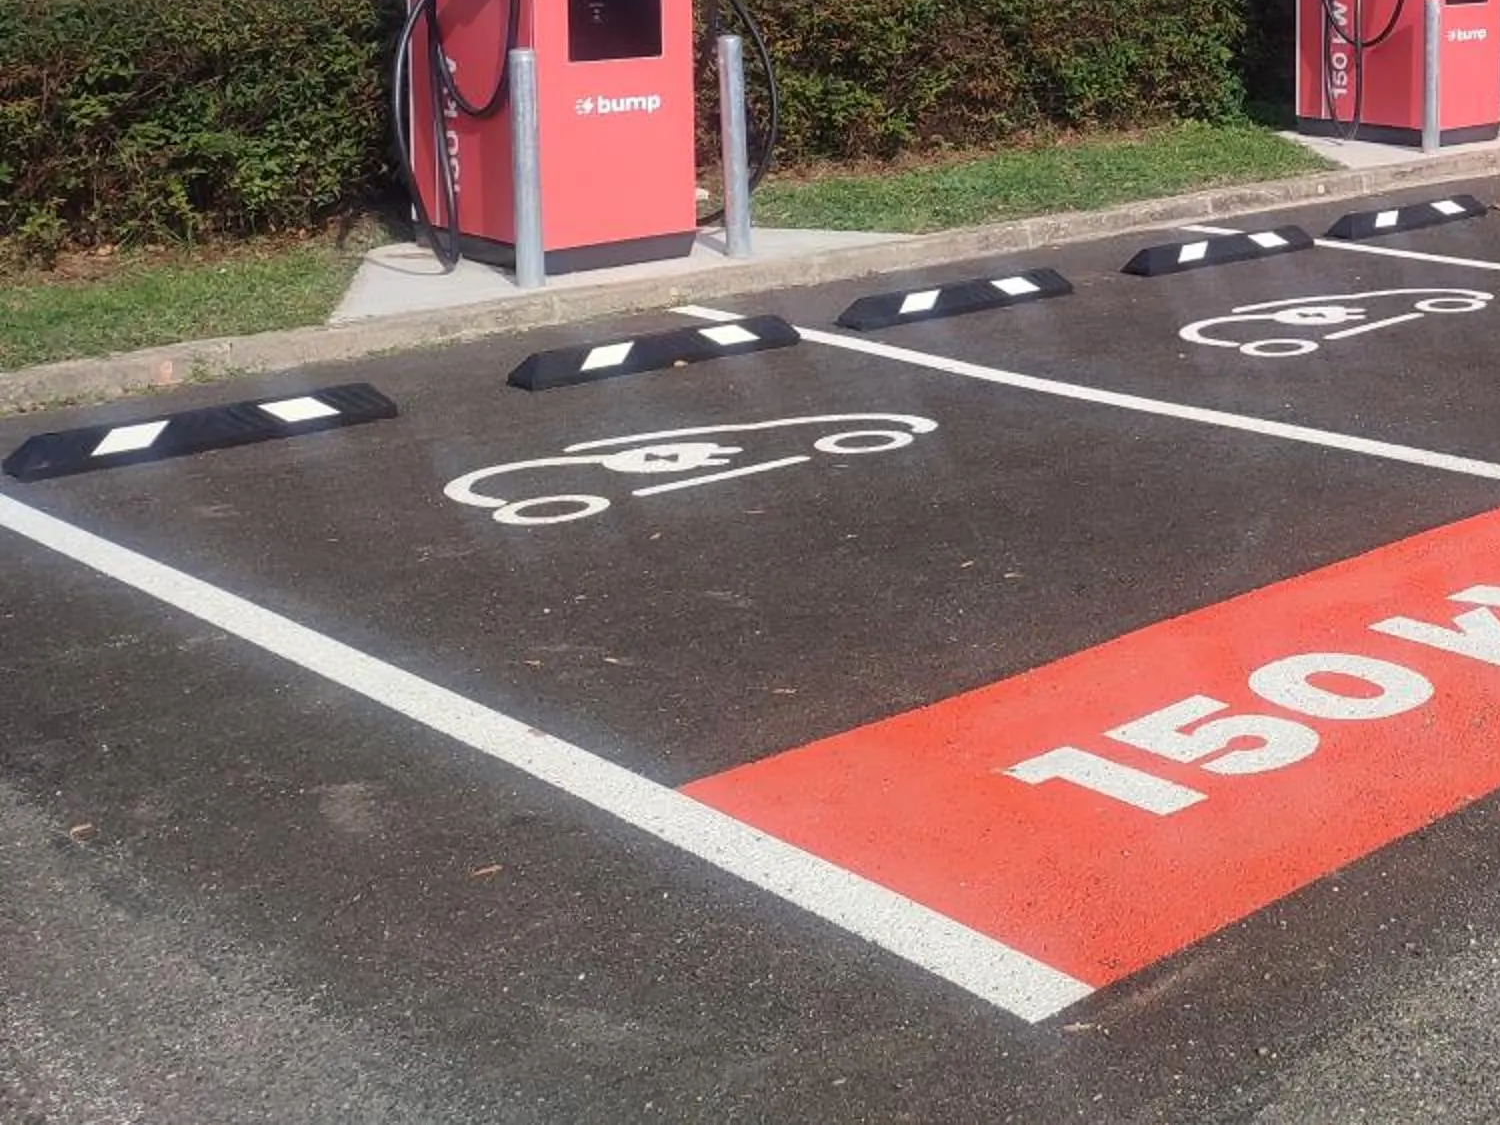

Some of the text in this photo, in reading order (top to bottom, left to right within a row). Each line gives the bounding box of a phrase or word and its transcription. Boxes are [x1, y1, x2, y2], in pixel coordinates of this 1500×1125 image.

[1331, 52, 1348, 99] 150
[596, 93, 662, 115] bump
[1002, 650, 1435, 816] 150
